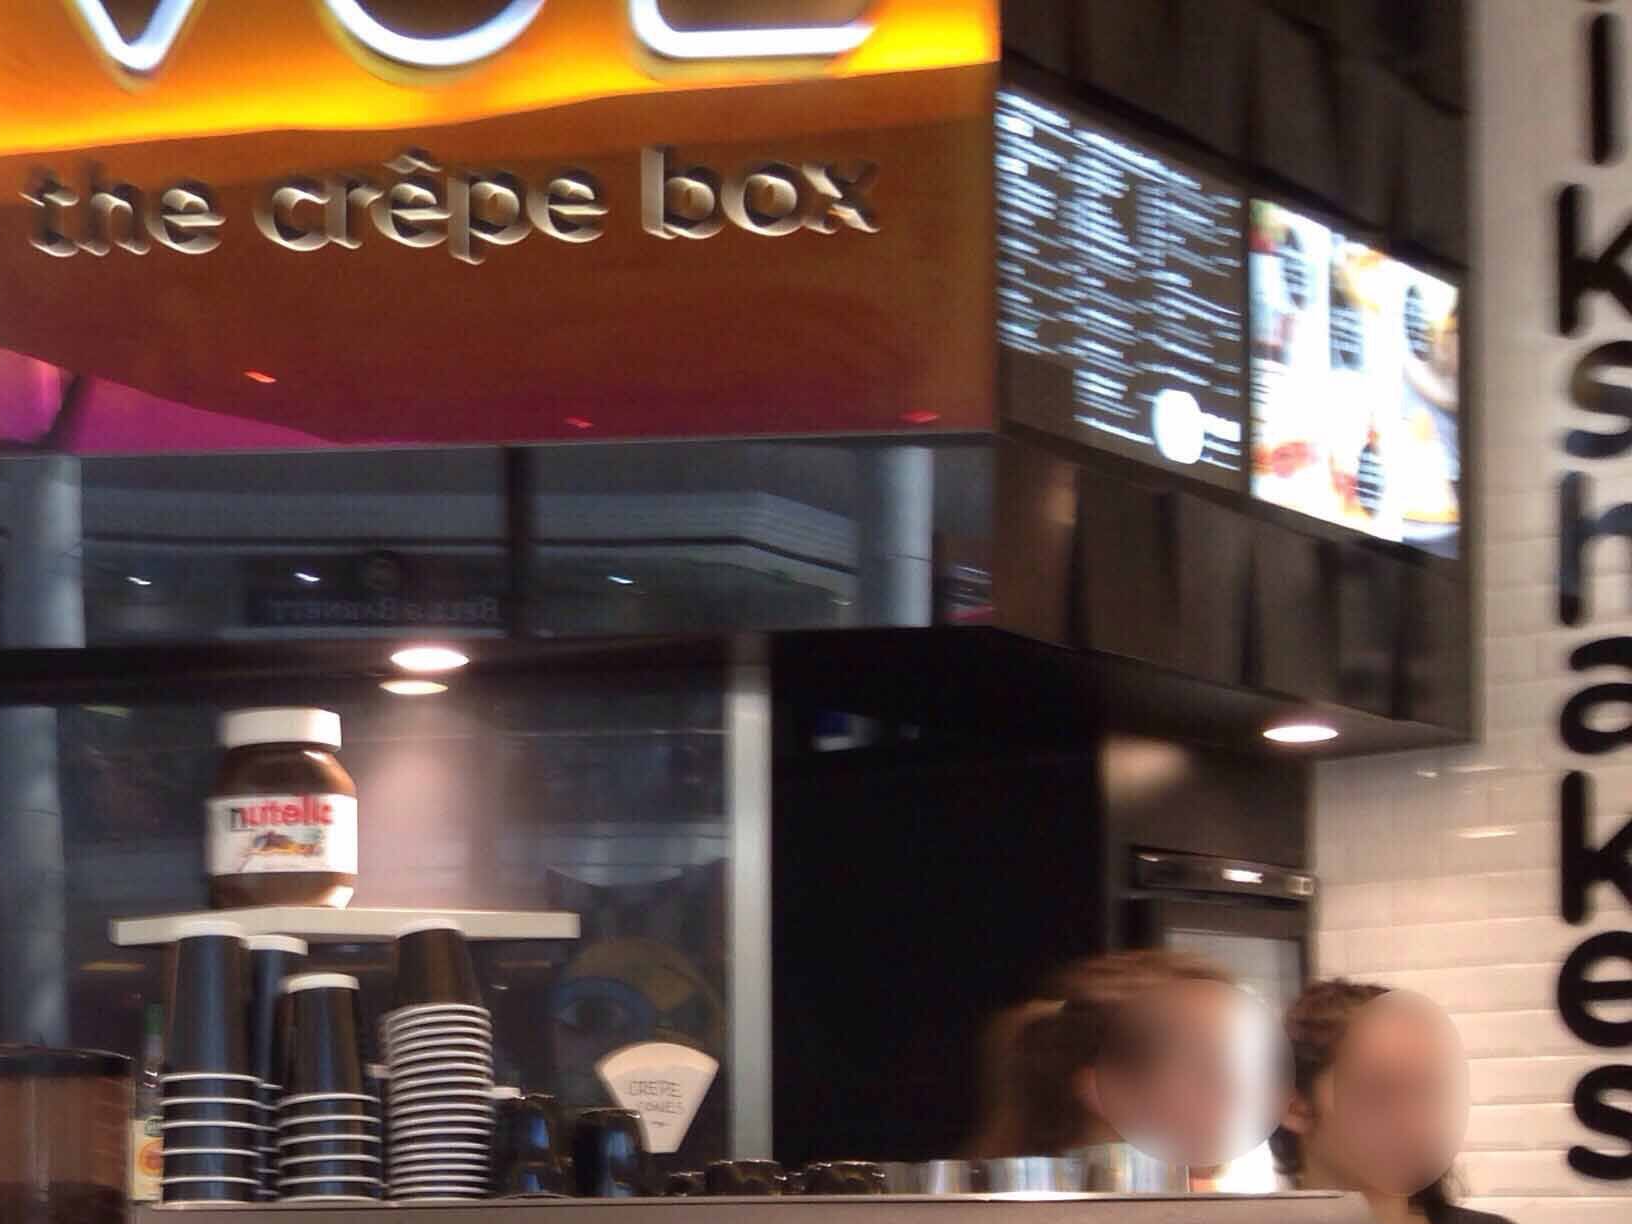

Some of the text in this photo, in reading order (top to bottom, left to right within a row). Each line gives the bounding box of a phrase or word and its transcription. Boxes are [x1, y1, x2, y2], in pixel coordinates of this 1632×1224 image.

[18, 146, 881, 265] the crêpe box
[1556, 0, 1632, 1181] lkshakes
